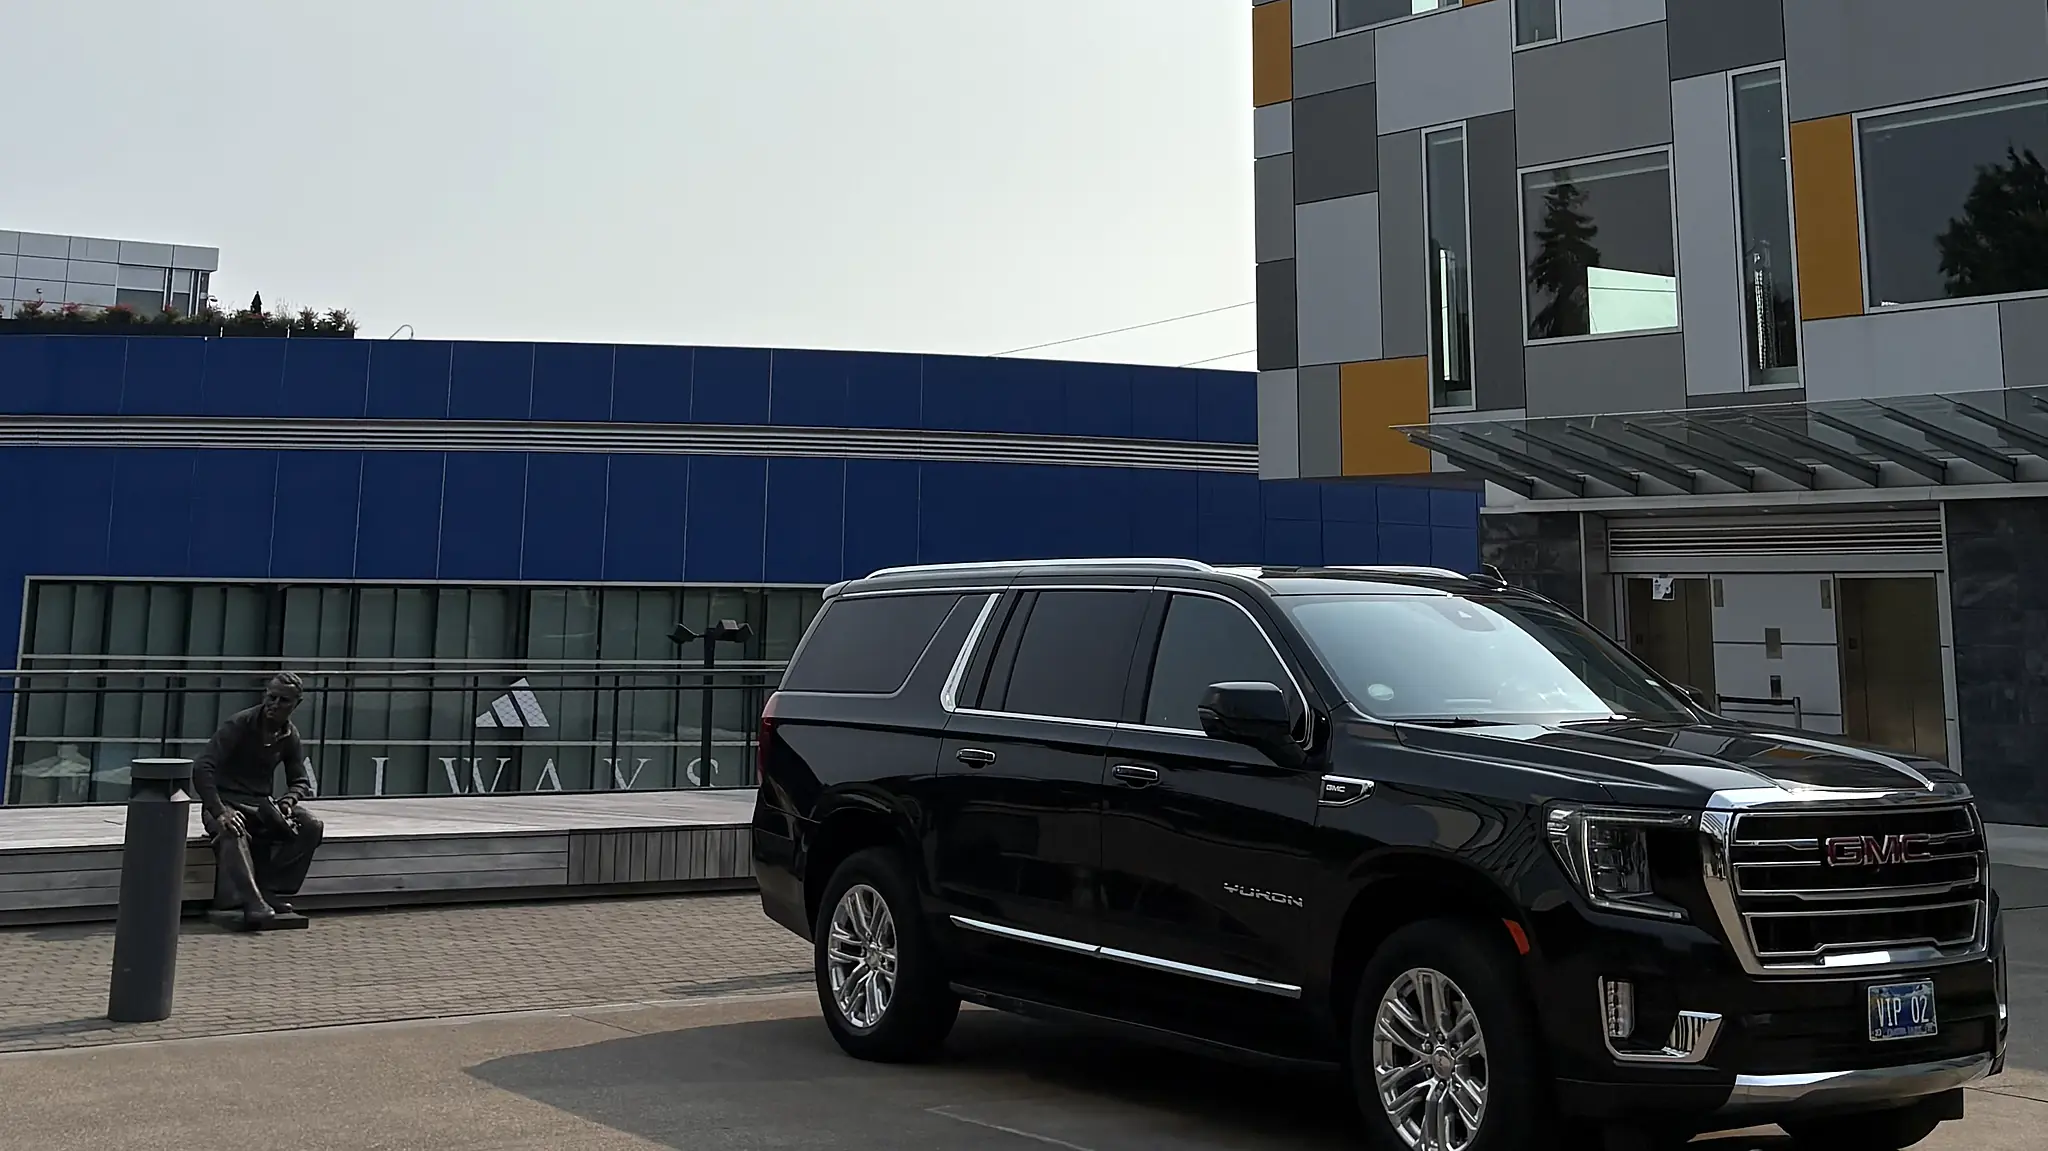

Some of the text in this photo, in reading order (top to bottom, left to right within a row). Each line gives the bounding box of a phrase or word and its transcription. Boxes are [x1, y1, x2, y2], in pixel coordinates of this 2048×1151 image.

[1326, 784, 1346, 793] GMC
[1826, 833, 1931, 867] GMC
[1223, 882, 1304, 908] YUKON
[1876, 995, 1930, 1027] VIP 02
